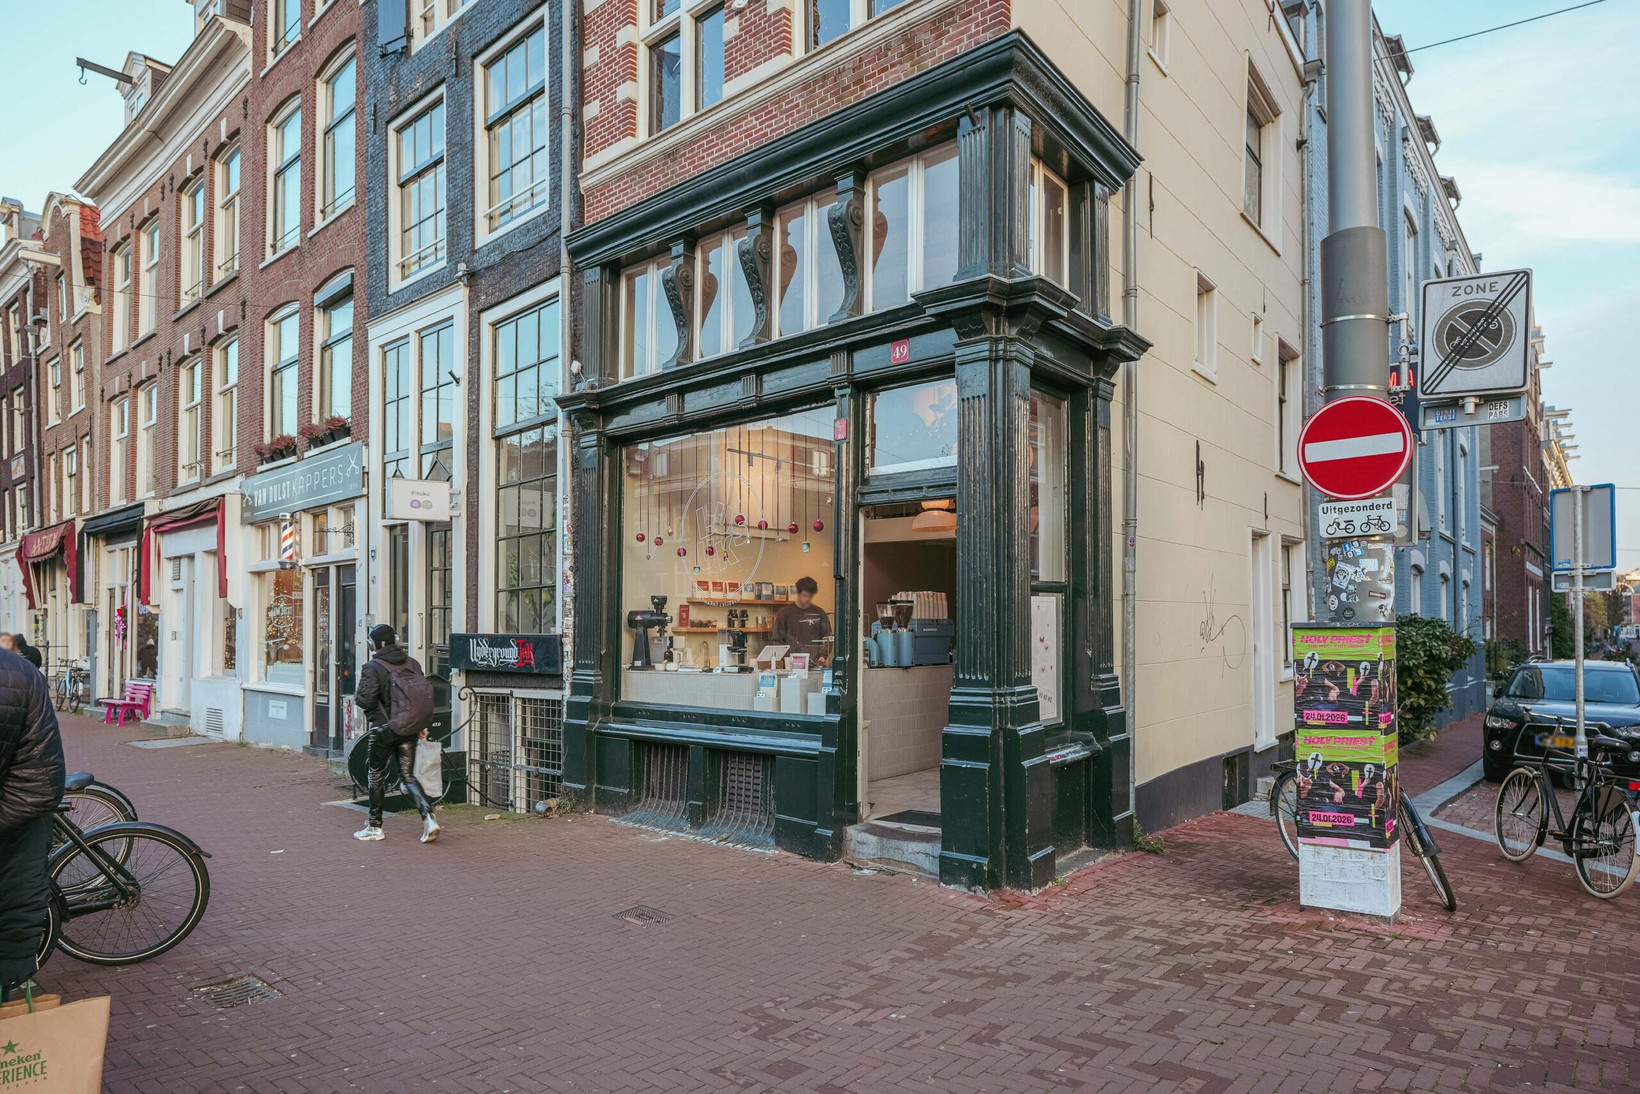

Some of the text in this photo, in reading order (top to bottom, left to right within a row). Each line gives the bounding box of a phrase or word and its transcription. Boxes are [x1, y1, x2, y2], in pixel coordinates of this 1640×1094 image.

[1451, 281, 1499, 297] ZONE
[893, 344, 908, 359] 49
[1488, 401, 1508, 411] DEFS
[254, 464, 344, 507] VAN DULST KAPPERS
[1321, 500, 1393, 516] Uitgezonderd
[1300, 635, 1330, 644] HOLY
[1330, 633, 1373, 645] PRIEST
[469, 637, 520, 668] Underground
[1305, 712, 1347, 722] 24.01.2026
[1303, 735, 1376, 746] HOLY PRIEST
[1311, 813, 1353, 825] 24.01.2026
[0, 1052, 41, 1069] neken
[0, 1060, 48, 1086] RIENCE
